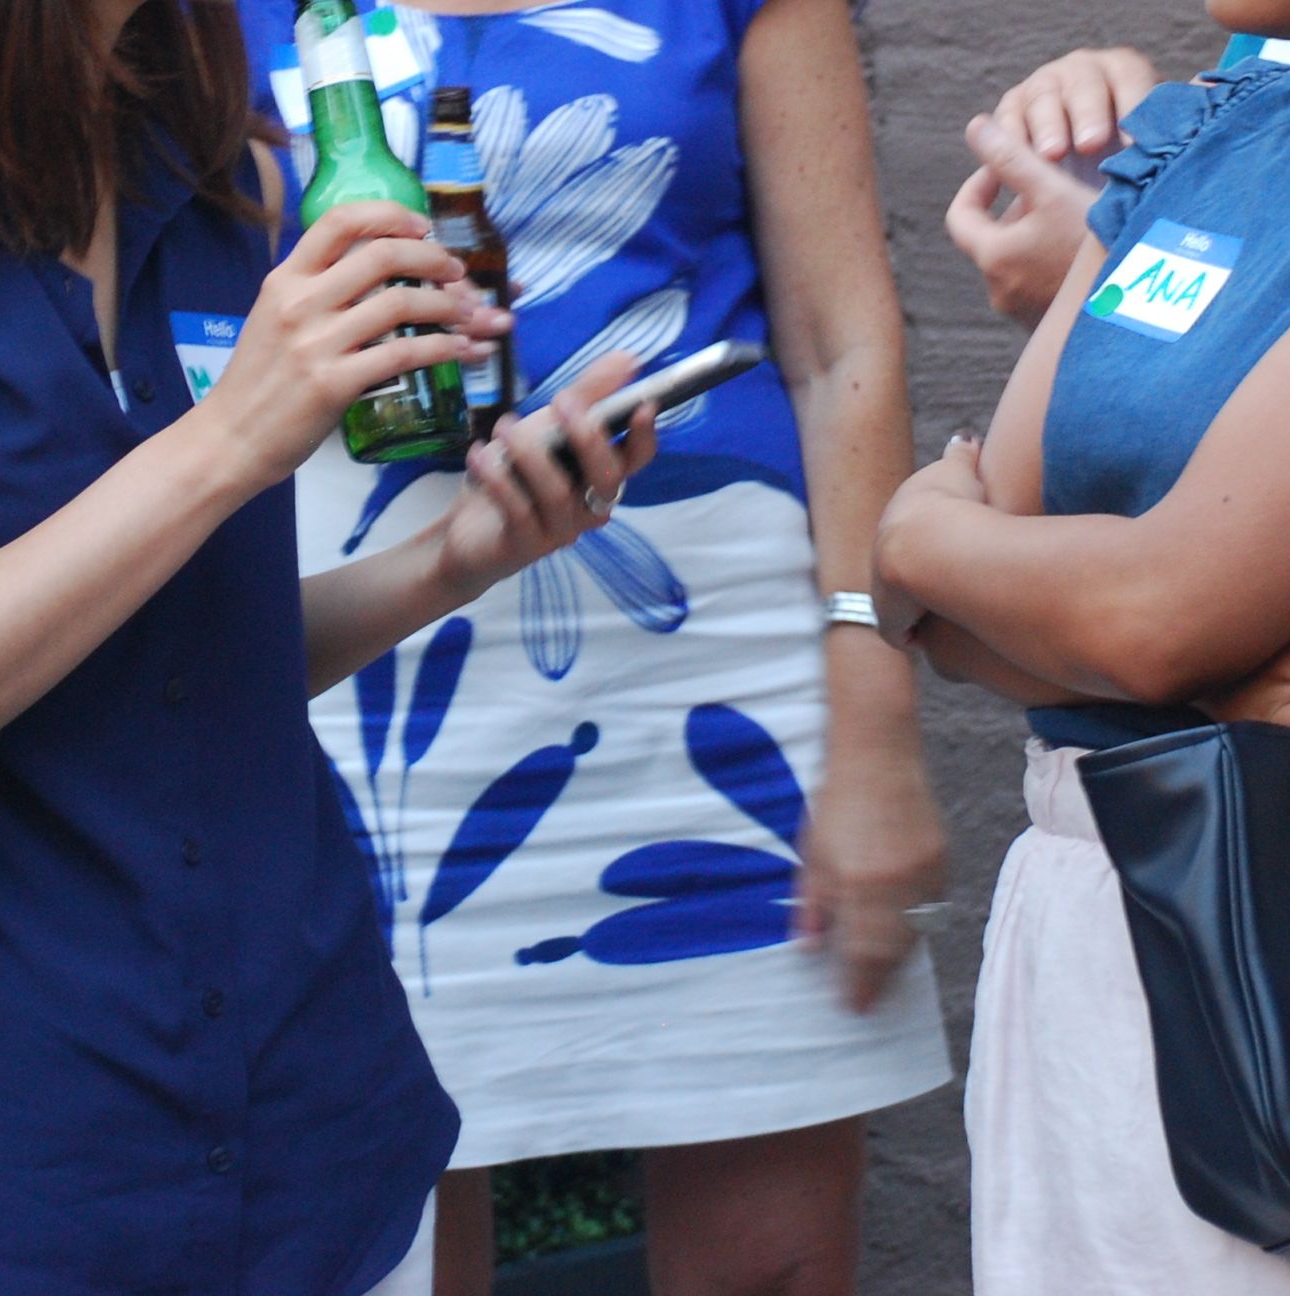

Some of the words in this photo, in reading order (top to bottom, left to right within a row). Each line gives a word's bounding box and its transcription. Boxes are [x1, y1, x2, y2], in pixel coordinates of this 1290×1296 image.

[1179, 231, 1213, 253] Hello
[1123, 258, 1208, 312] ANA
[203, 319, 237, 338] Hello
